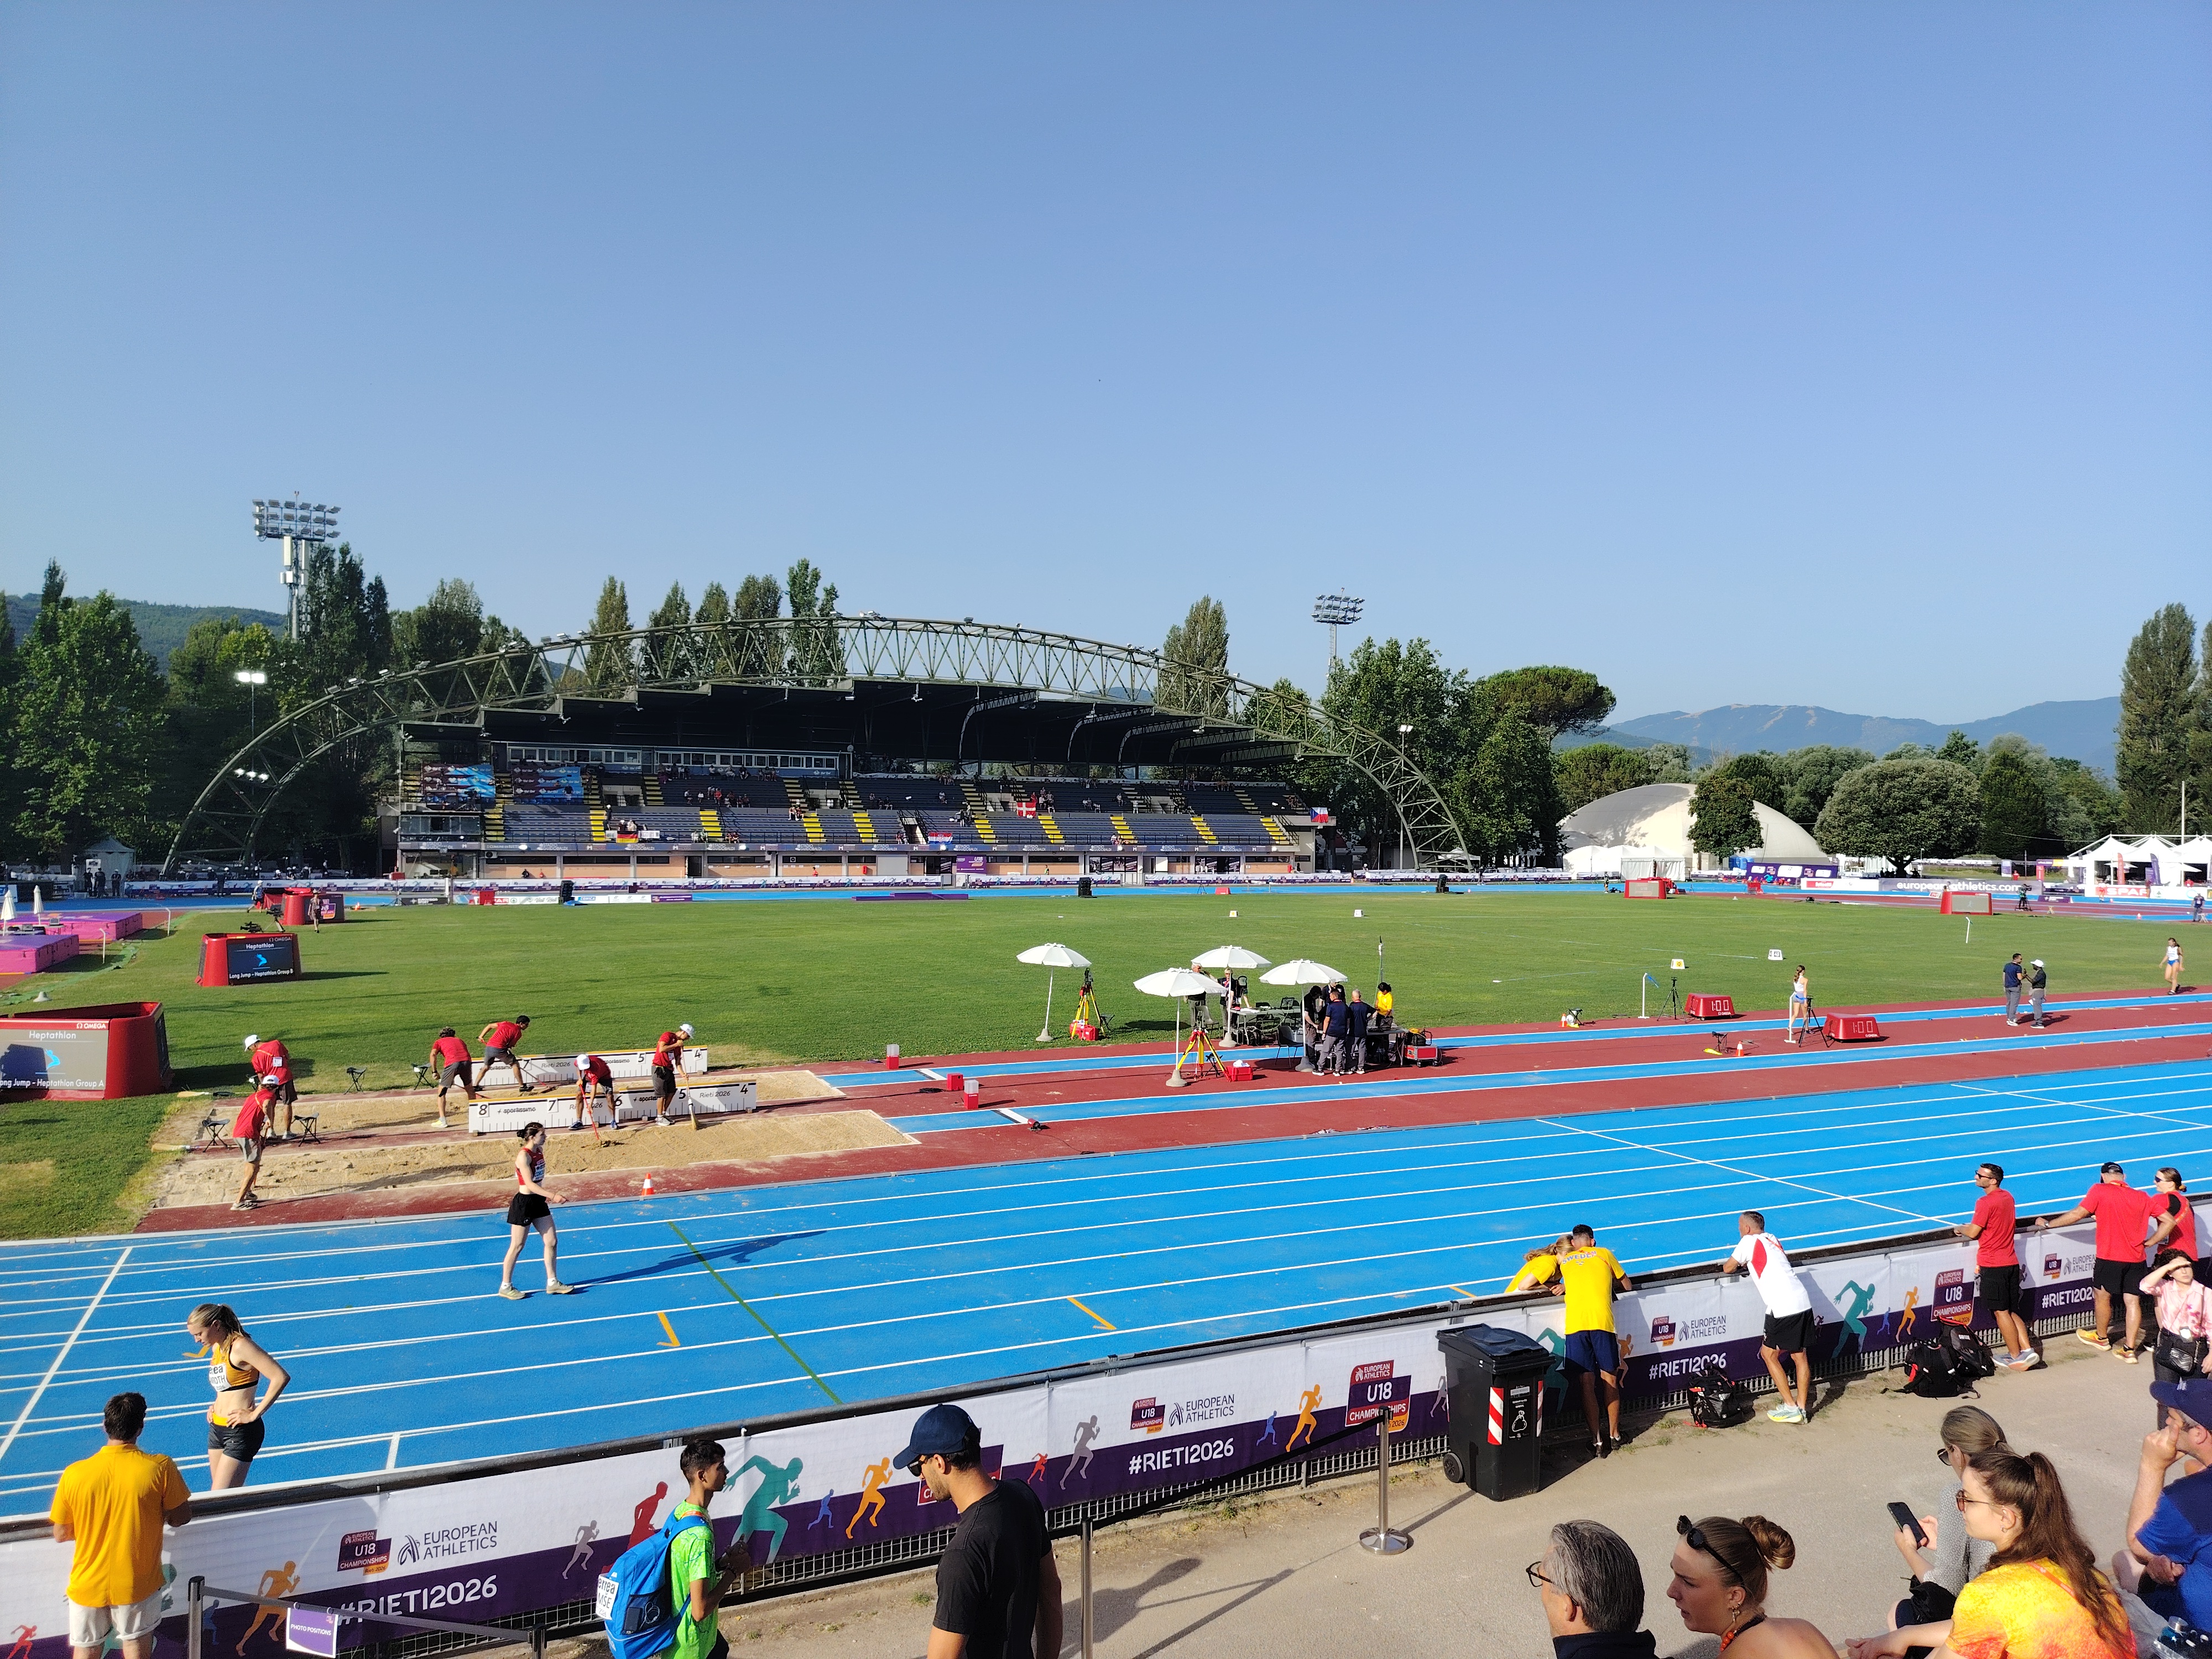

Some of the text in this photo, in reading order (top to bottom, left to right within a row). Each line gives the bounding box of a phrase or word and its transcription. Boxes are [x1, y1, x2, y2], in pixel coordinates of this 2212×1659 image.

[1712, 1000, 1729, 1011] 1:00
[1853, 1021, 1873, 1034] 1:00
[29, 1030, 76, 1041] Heptathlon
[638, 1053, 644, 1063] 5
[694, 1050, 701, 1058] 4
[523, 1060, 530, 1069] 7
[0, 1079, 12, 1088] ong
[13, 1078, 31, 1089] Jump
[37, 1079, 74, 1088] Heptathlon
[76, 1079, 97, 1089] Group
[740, 1084, 748, 1094] 4
[679, 1089, 686, 1099] 5
[549, 1099, 557, 1112] 7
[615, 1095, 623, 1106] 6
[479, 1104, 488, 1115] 8
[1562, 1250, 1597, 1264] SWEDEN
[2073, 1254, 2096, 1265] EUROPEA
[2072, 1262, 2095, 1273] ATHLETIC
[1945, 1286, 1963, 1302] U18
[2042, 1286, 2094, 1308] #RIETI202
[1933, 1303, 1971, 1317] CHAMPIONSHIPS
[1691, 1315, 1726, 1329] EUROPEAN
[1658, 1325, 1669, 1334] U18
[1691, 1325, 1726, 1339] ATHLETICS
[1364, 1363, 1390, 1373] EUROPEAN
[1364, 1370, 1390, 1380] ATHLETICS
[1367, 1381, 1392, 1402] U18
[1186, 1394, 1235, 1411] EUROPEAN
[1141, 1408, 1155, 1419] U18
[1186, 1406, 1234, 1423] ATHLETICS
[1131, 1418, 1162, 1428] CHAMPIONSHIPS
[1129, 1438, 1234, 1475] #RIETI2026
[352, 1531, 374, 1539] EUROPEAN
[424, 1521, 498, 1546] EUROPEAN
[355, 1542, 376, 1557] U18
[423, 1536, 498, 1560] ATHLETICS
[340, 1555, 388, 1569] CHAMPIONSHIPS
[598, 1578, 616, 1595] errea
[337, 1574, 497, 1626] #RIETI2026
[307, 1627, 332, 1636] POSITIONS
